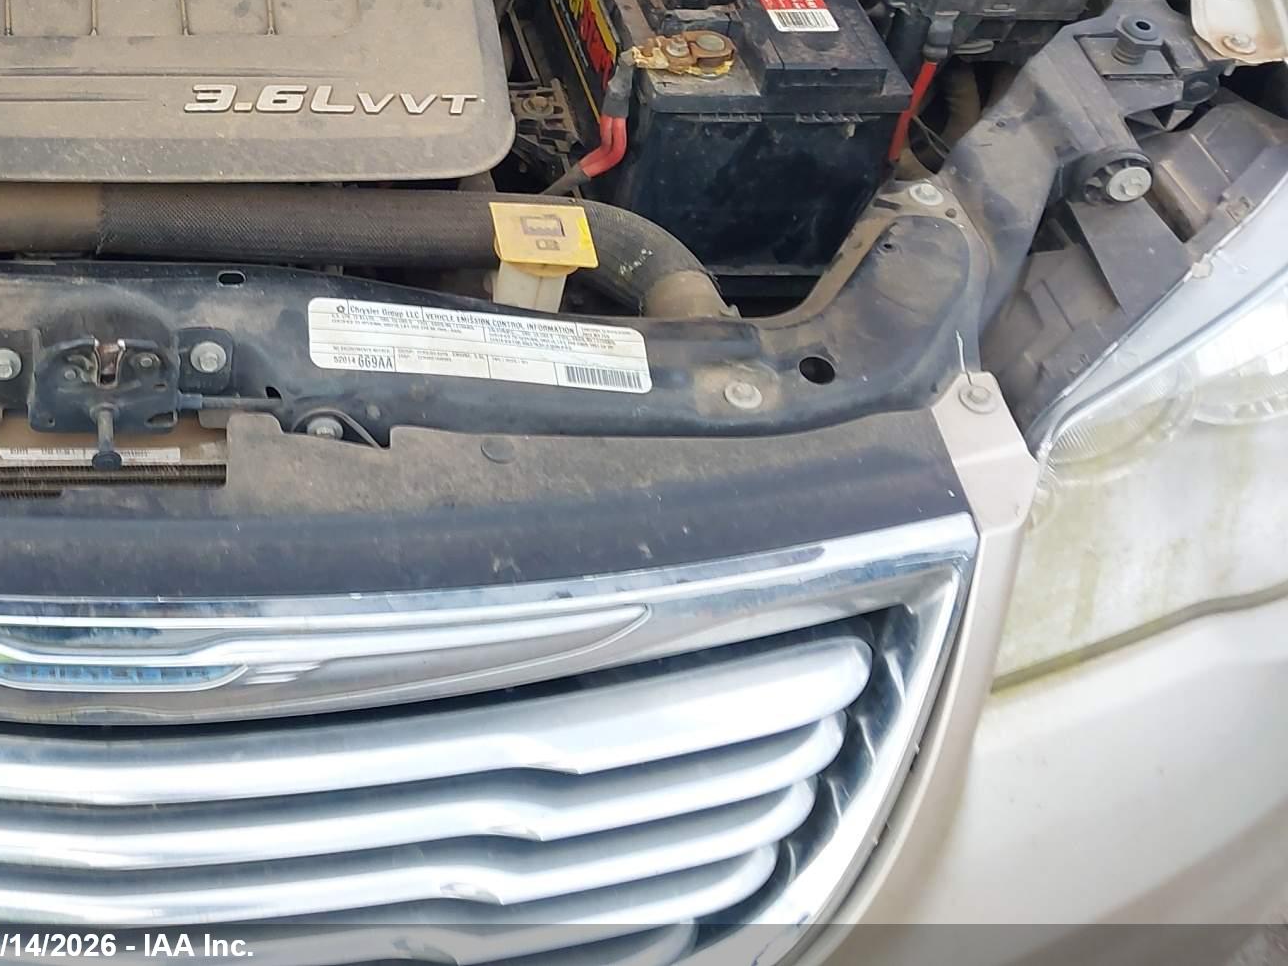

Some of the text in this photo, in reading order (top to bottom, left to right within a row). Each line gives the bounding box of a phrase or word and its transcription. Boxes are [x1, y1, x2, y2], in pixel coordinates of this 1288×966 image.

[350, 305, 380, 316] Chrysler
[425, 312, 454, 323] VEHICLE
[491, 319, 524, 330] CONTROL
[527, 323, 575, 334] INFORMATION
